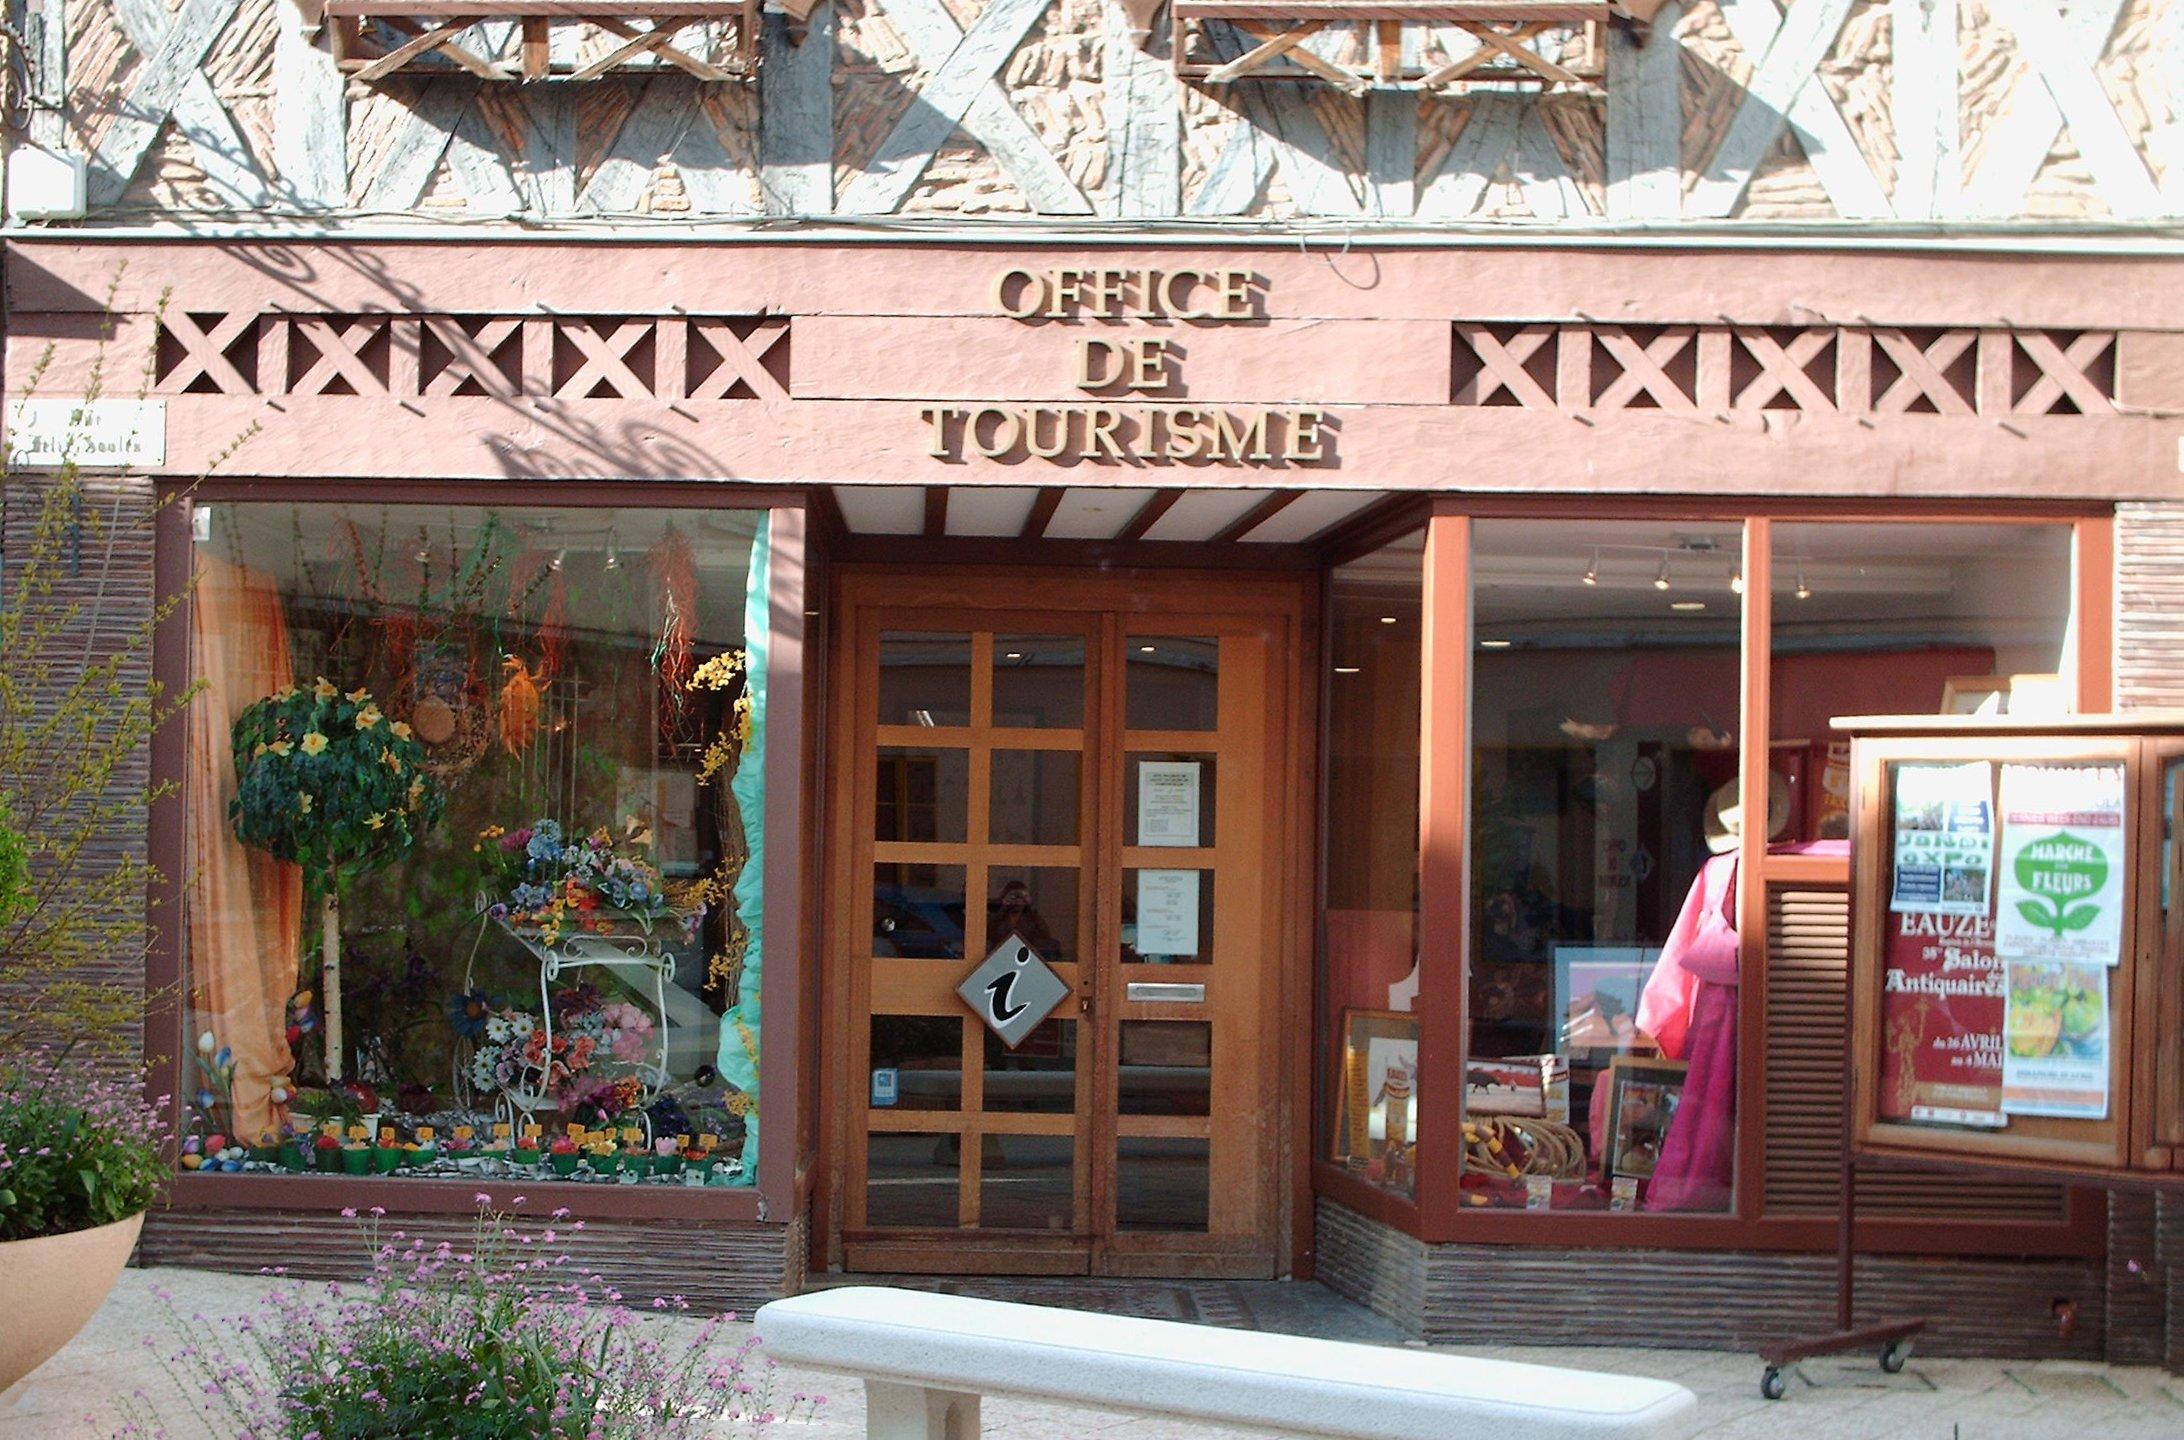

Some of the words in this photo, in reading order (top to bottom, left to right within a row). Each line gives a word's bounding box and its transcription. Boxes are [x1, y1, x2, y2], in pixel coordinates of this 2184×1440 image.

[990, 268, 1254, 320] OFFICE
[1075, 337, 1168, 389] DE
[920, 405, 1324, 461] TOURISME
[2032, 871, 2092, 895] FLEURS
[1900, 912, 1990, 937] EAUZE
